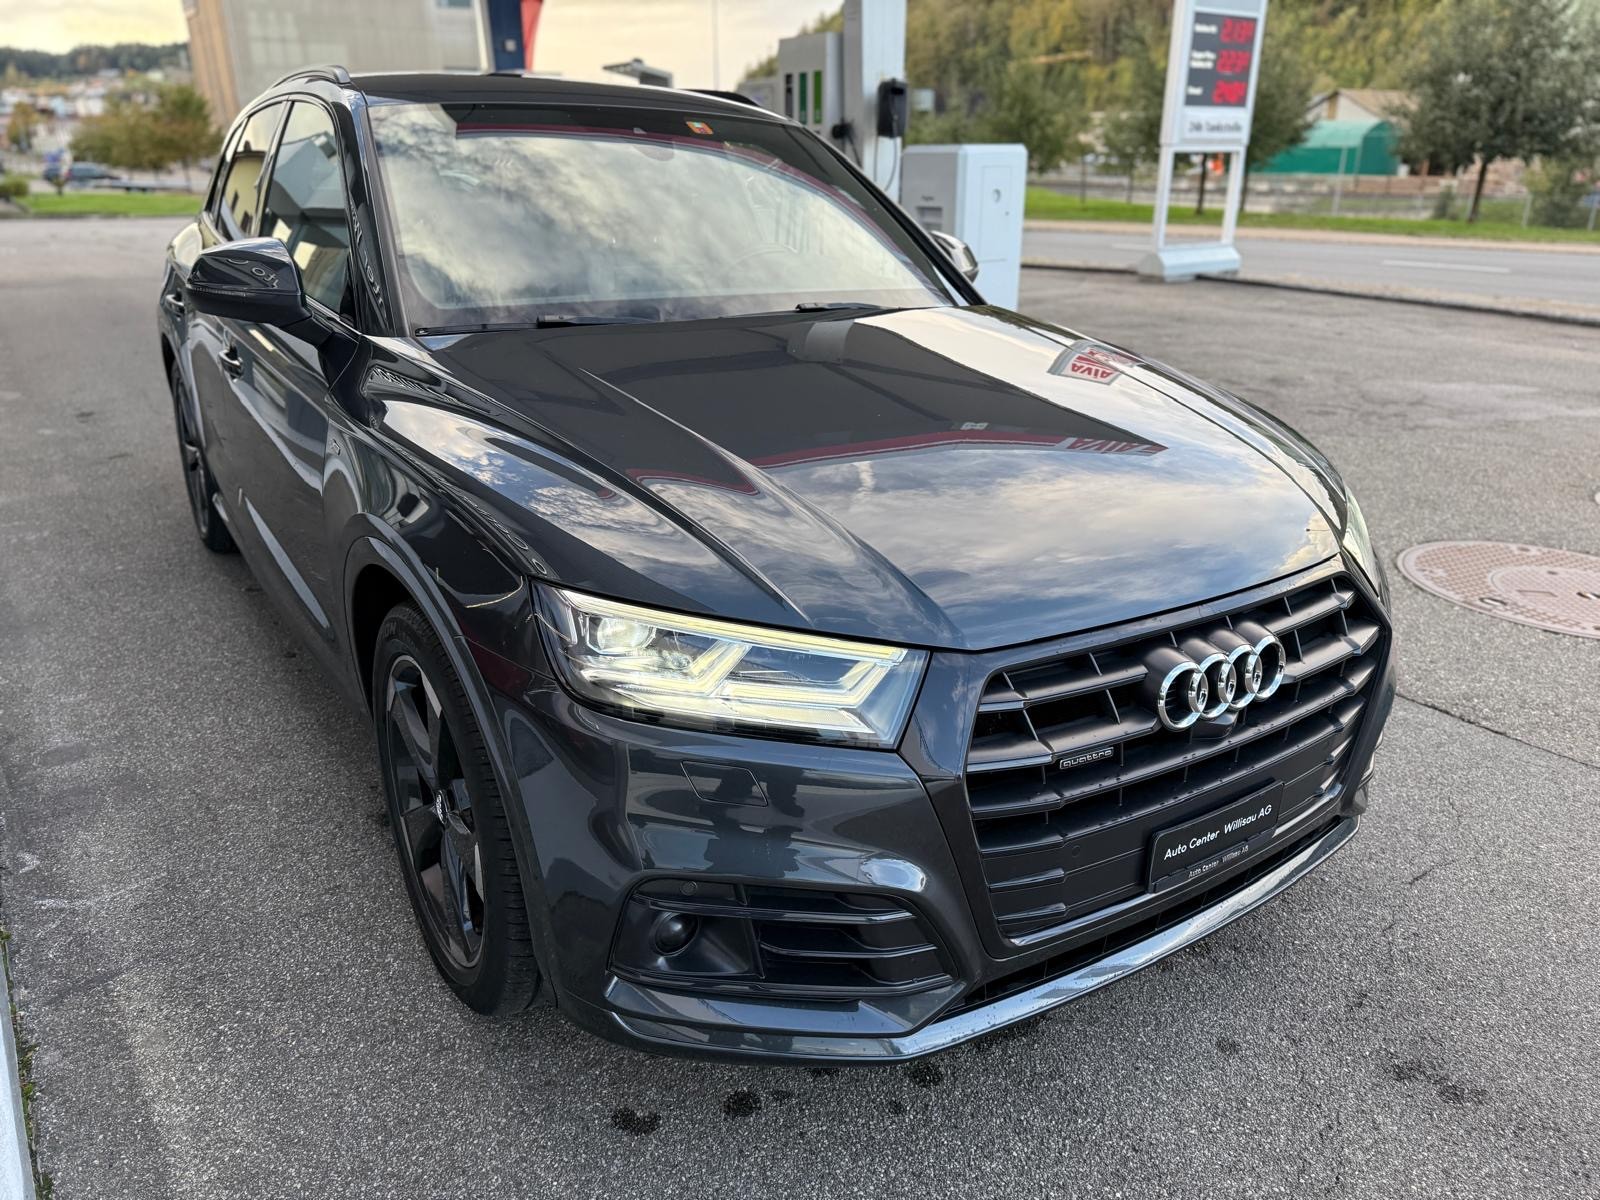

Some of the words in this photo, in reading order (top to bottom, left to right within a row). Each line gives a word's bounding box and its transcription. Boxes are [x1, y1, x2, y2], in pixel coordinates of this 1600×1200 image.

[1063, 750, 1112, 767] quattro
[1163, 843, 1188, 860] Auto
[1188, 829, 1221, 849] Center
[1223, 813, 1257, 834] Willisau
[1257, 804, 1273, 819] AG
[1188, 868, 1202, 879] Auto
[1202, 860, 1220, 872] Center
